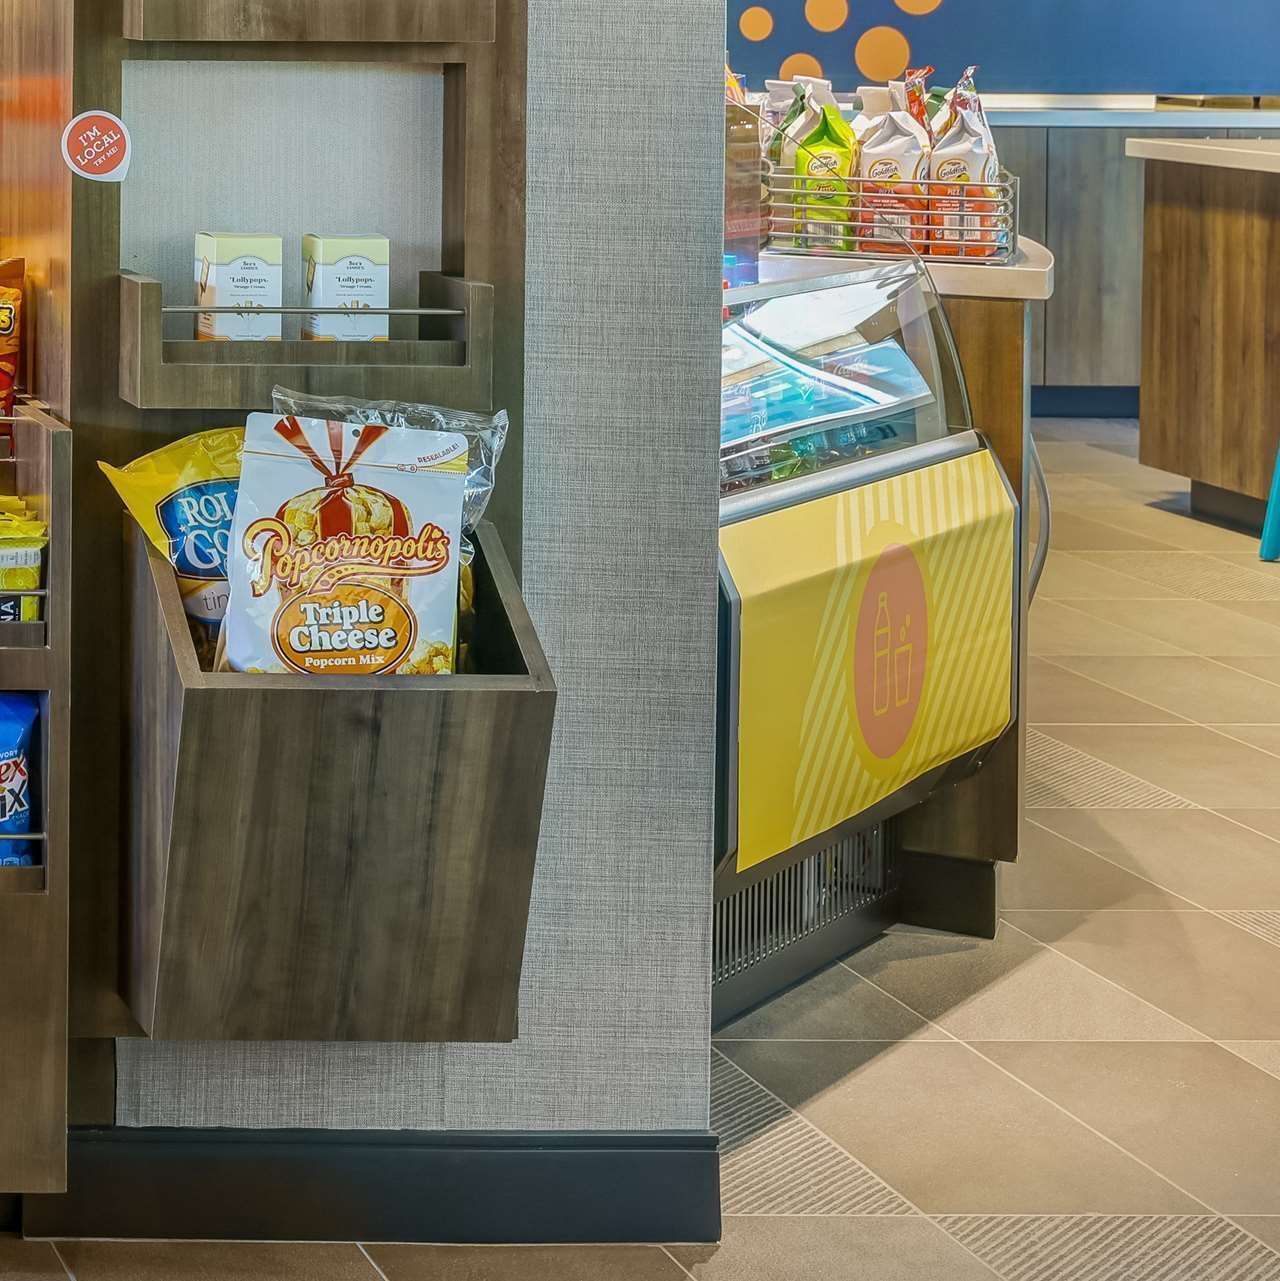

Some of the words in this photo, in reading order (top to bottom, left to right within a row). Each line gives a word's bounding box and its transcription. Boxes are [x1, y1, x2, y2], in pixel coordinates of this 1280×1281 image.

[79, 125, 101, 147] I'M
[75, 127, 120, 167] LOCAL
[93, 155, 106, 168] TRY
[811, 160, 838, 171] Goldfish
[872, 166, 898, 178] Goldfish
[940, 166, 967, 178] Goldfish
[244, 518, 449, 597] Popcornopolis
[301, 600, 384, 629] Triple
[290, 624, 396, 652] Cheese
[305, 656, 355, 669] Popcorn
[359, 653, 384, 664] Mix
